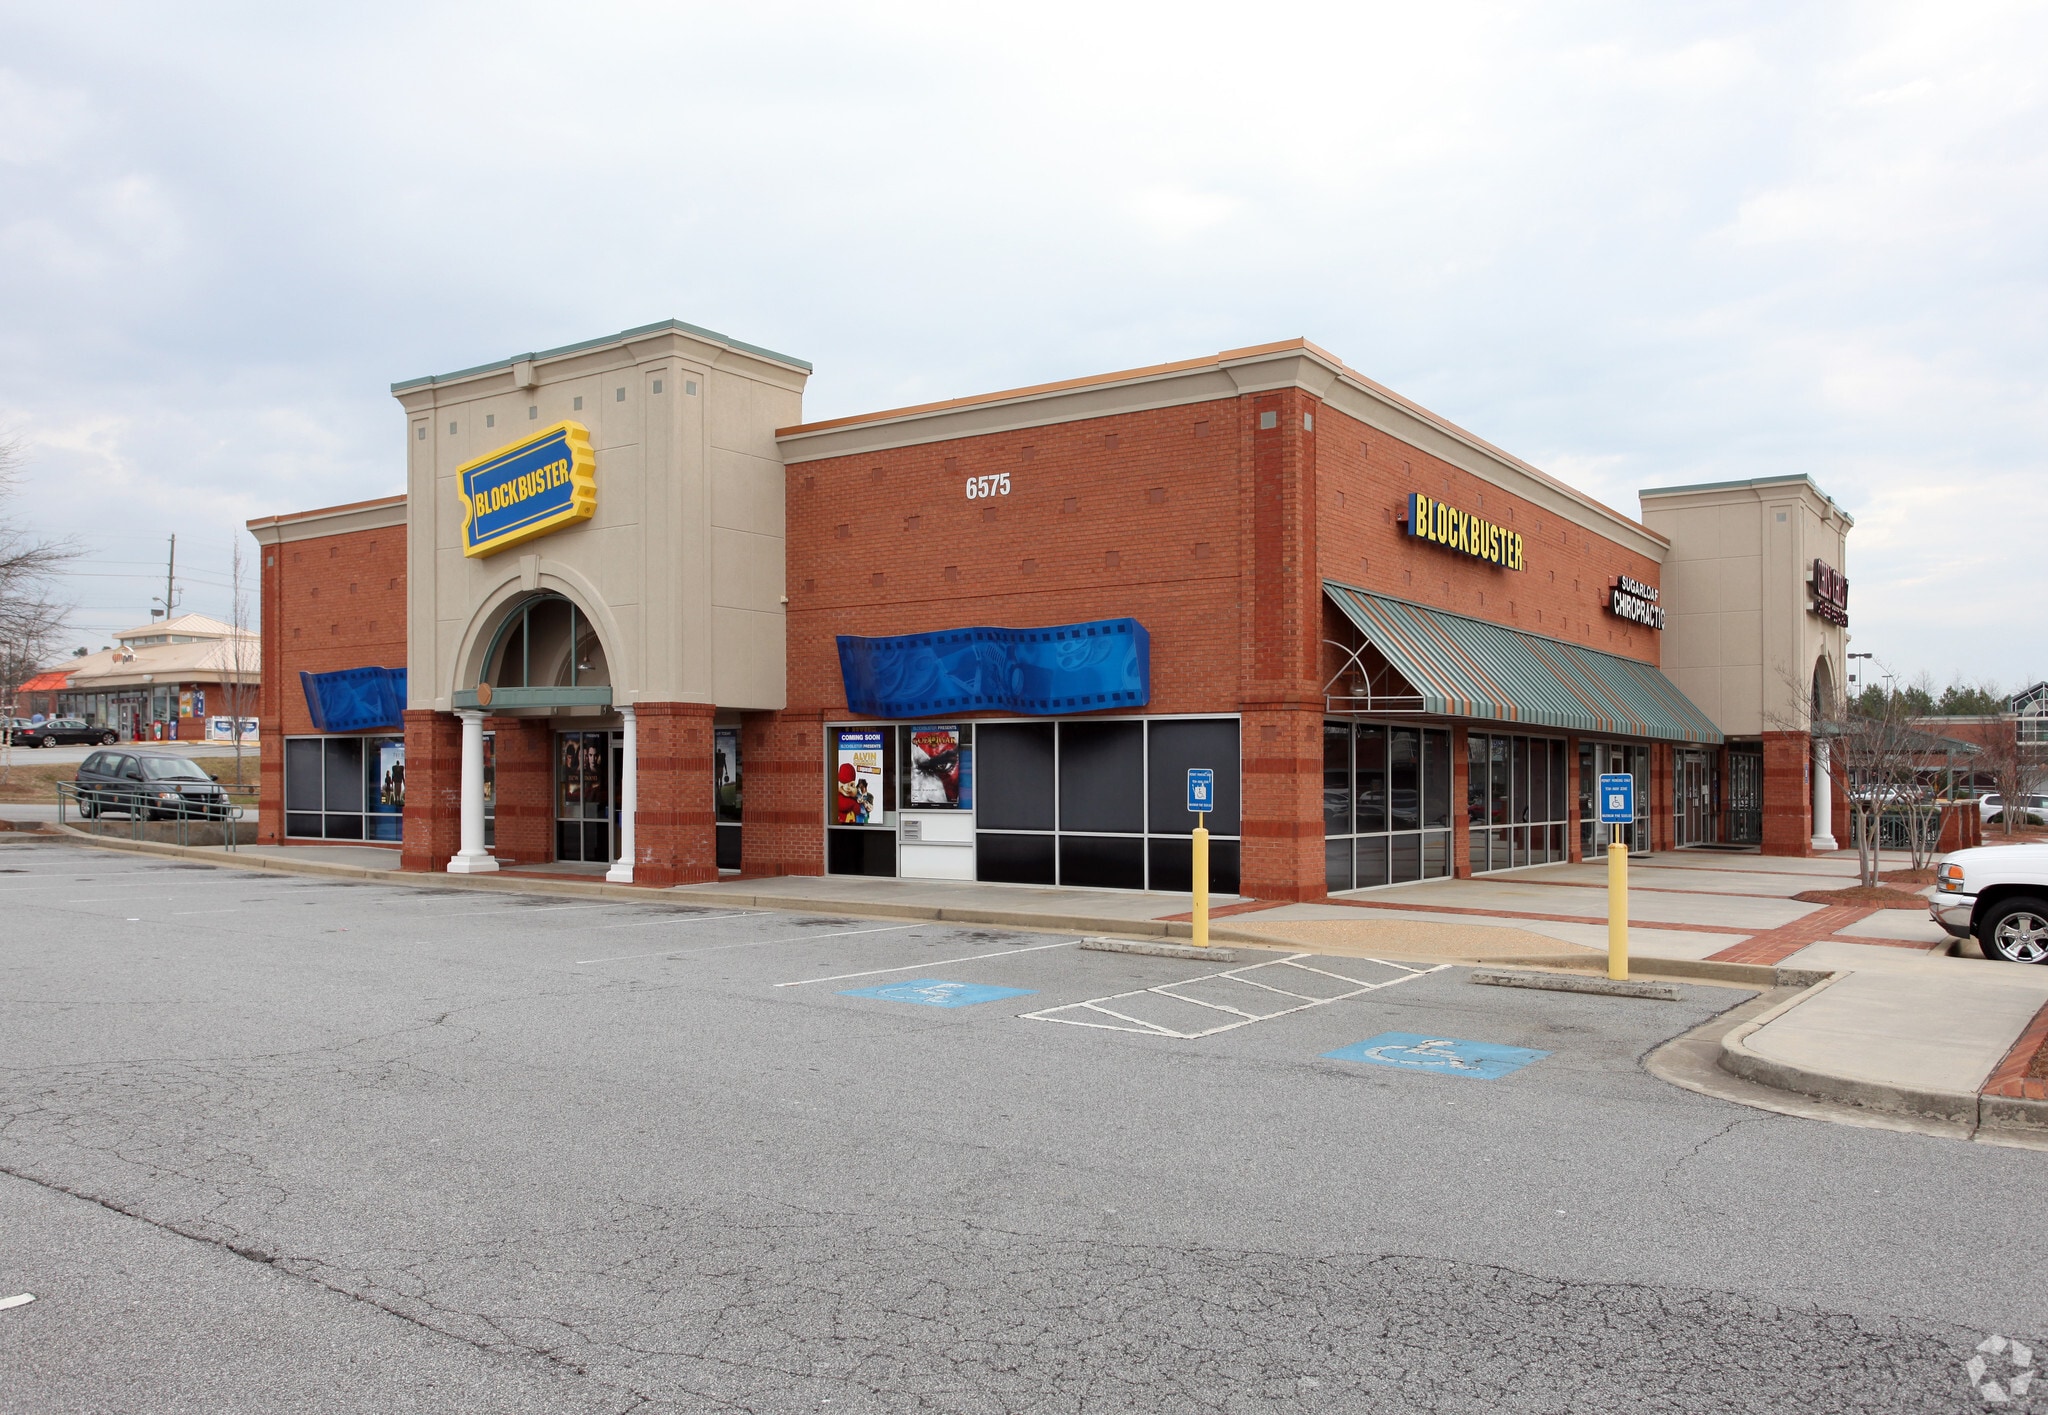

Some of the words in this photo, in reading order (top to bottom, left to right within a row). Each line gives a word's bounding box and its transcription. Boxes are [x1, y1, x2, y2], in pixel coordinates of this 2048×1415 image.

[474, 458, 570, 518] BLOCKBUSTER
[966, 472, 1011, 500] 6575
[1415, 492, 1523, 572] BLOCKBUSTER
[1621, 575, 1659, 602] SUGARLOAF
[1613, 589, 1666, 631] CHIROPRACTIC
[853, 752, 877, 761] ALVIN
